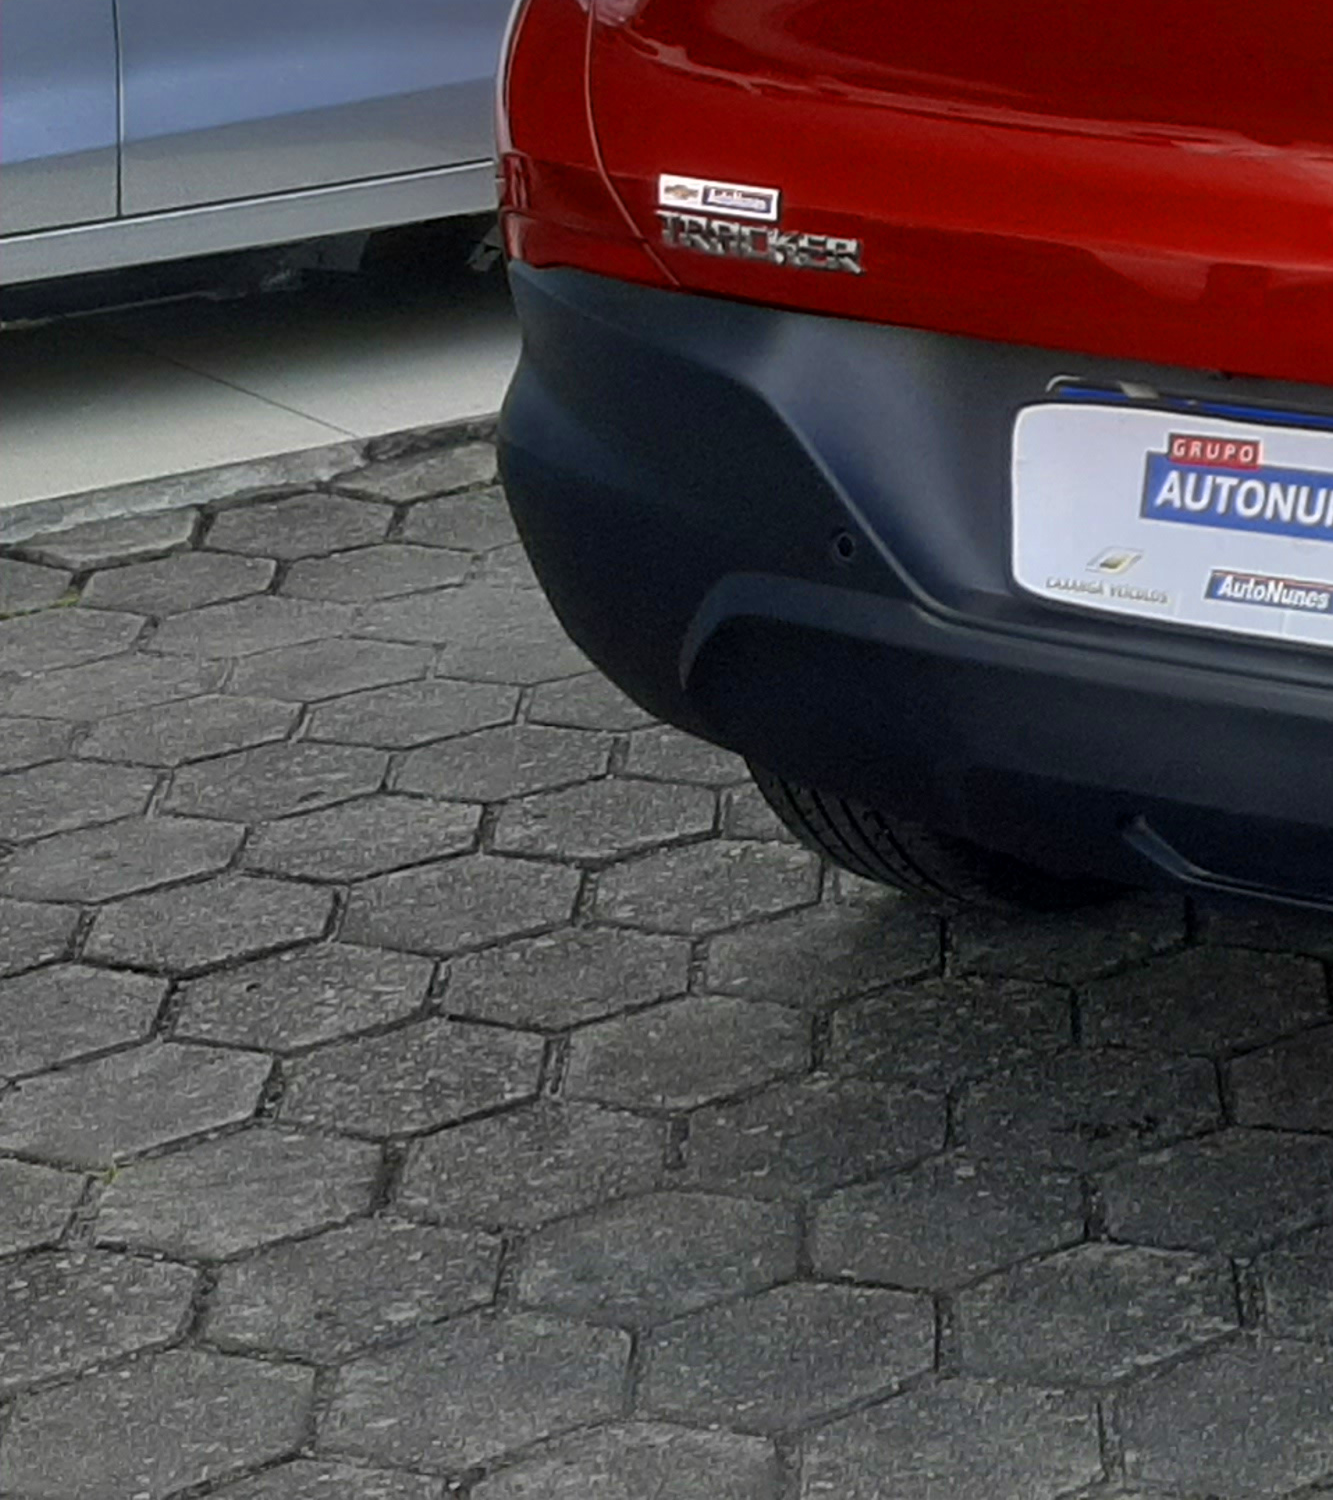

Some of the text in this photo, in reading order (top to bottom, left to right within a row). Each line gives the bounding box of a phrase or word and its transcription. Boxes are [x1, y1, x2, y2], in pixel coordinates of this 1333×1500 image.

[654, 209, 864, 275] TRACKER
[1171, 438, 1255, 463] GRUPO
[1216, 574, 1331, 610] AutoNunes
